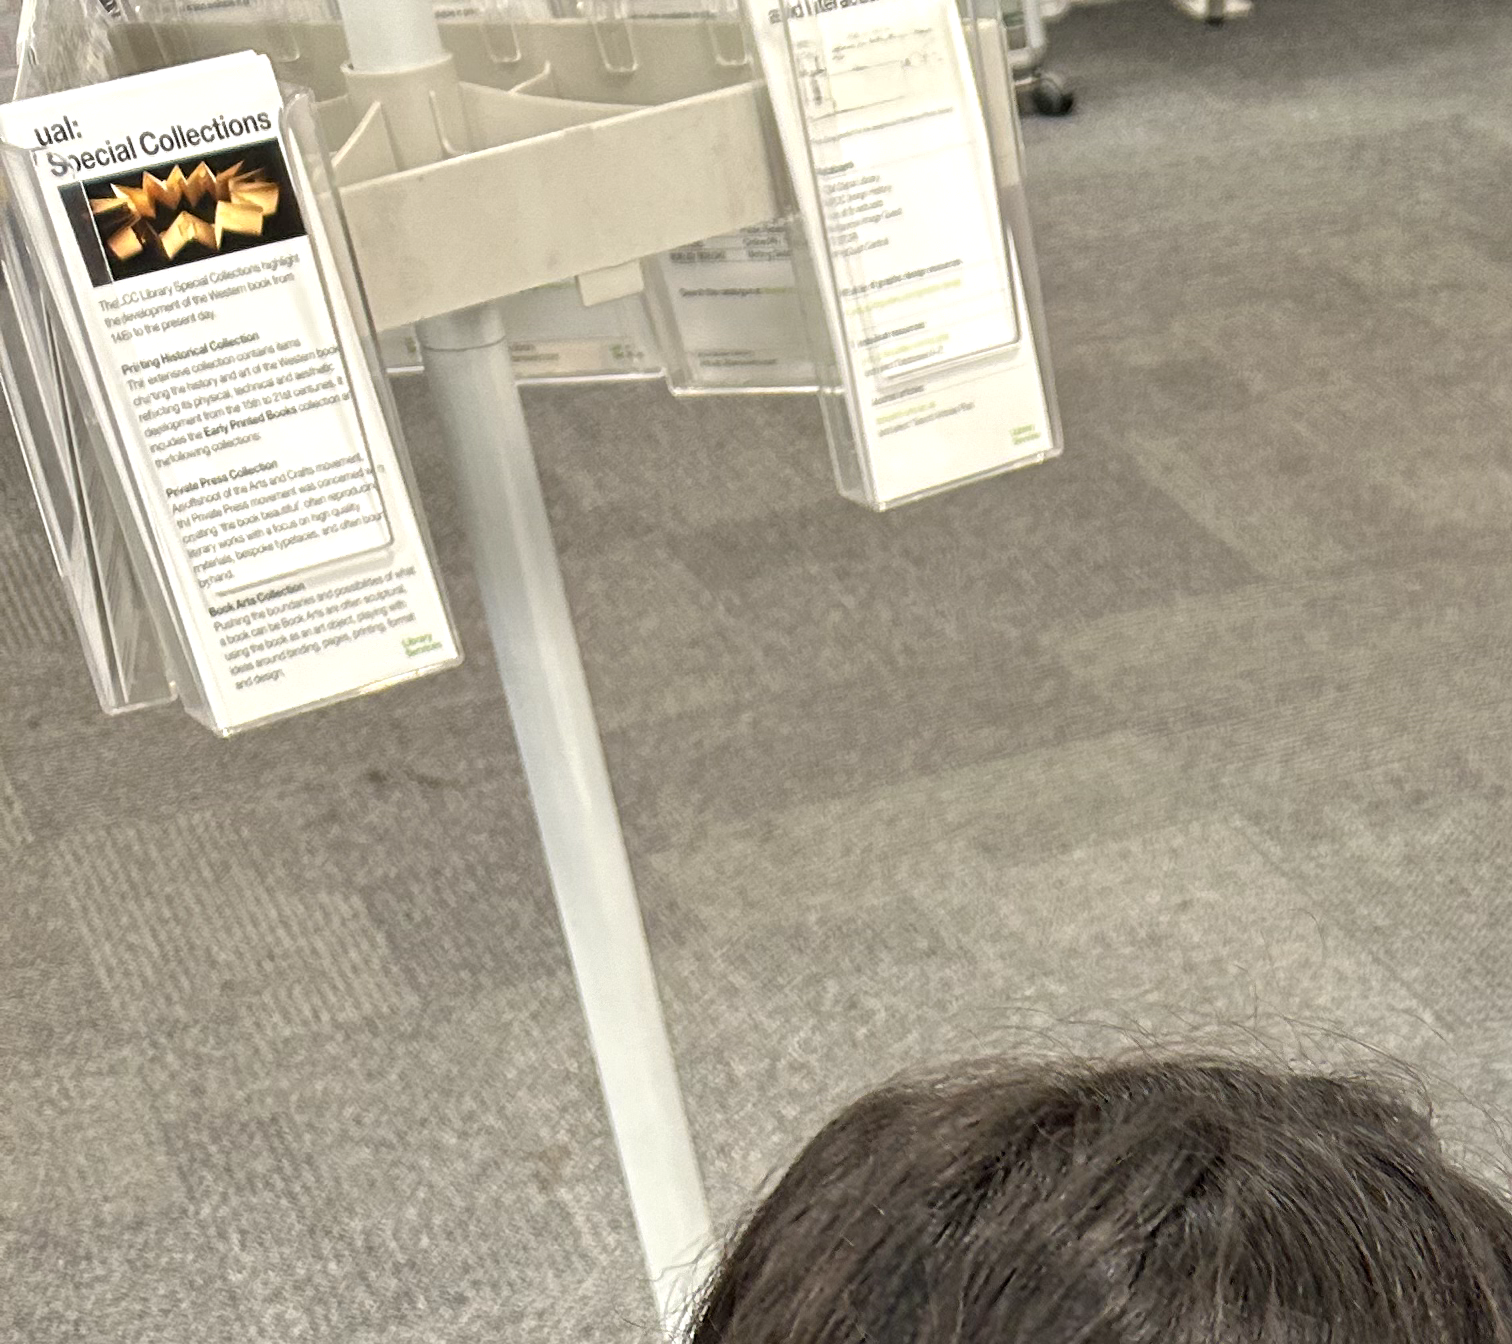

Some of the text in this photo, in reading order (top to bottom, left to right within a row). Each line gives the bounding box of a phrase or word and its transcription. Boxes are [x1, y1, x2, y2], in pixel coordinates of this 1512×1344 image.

[34, 116, 82, 147] ual:
[49, 109, 272, 177] Special Collections
[97, 297, 120, 312] The
[138, 285, 173, 302] Library
[173, 274, 210, 293] Special
[208, 264, 262, 284] Collections
[120, 299, 181, 325] development
[181, 295, 192, 309] of
[191, 294, 209, 306] the
[207, 285, 248, 302] Western
[247, 277, 273, 292] book
[271, 272, 295, 285] from
[132, 327, 145, 337] to
[143, 322, 161, 335] the
[160, 312, 197, 333] present
[120, 332, 260, 376] Printing Historical Collection
[147, 366, 192, 386] extensive
[191, 355, 236, 374] collection
[275, 338, 302, 352] items
[202, 405, 298, 438] Early Printed Books
[165, 460, 278, 499] Private Press Collection
[207, 582, 307, 618] Book Arts Collection
[213, 614, 252, 633] Pushing
[250, 610, 267, 621] the
[265, 595, 317, 618] boundaries
[316, 589, 335, 603] and
[333, 575, 385, 599] possibilities
[384, 570, 394, 583] of
[401, 633, 433, 651] Library
[235, 676, 254, 691] and
